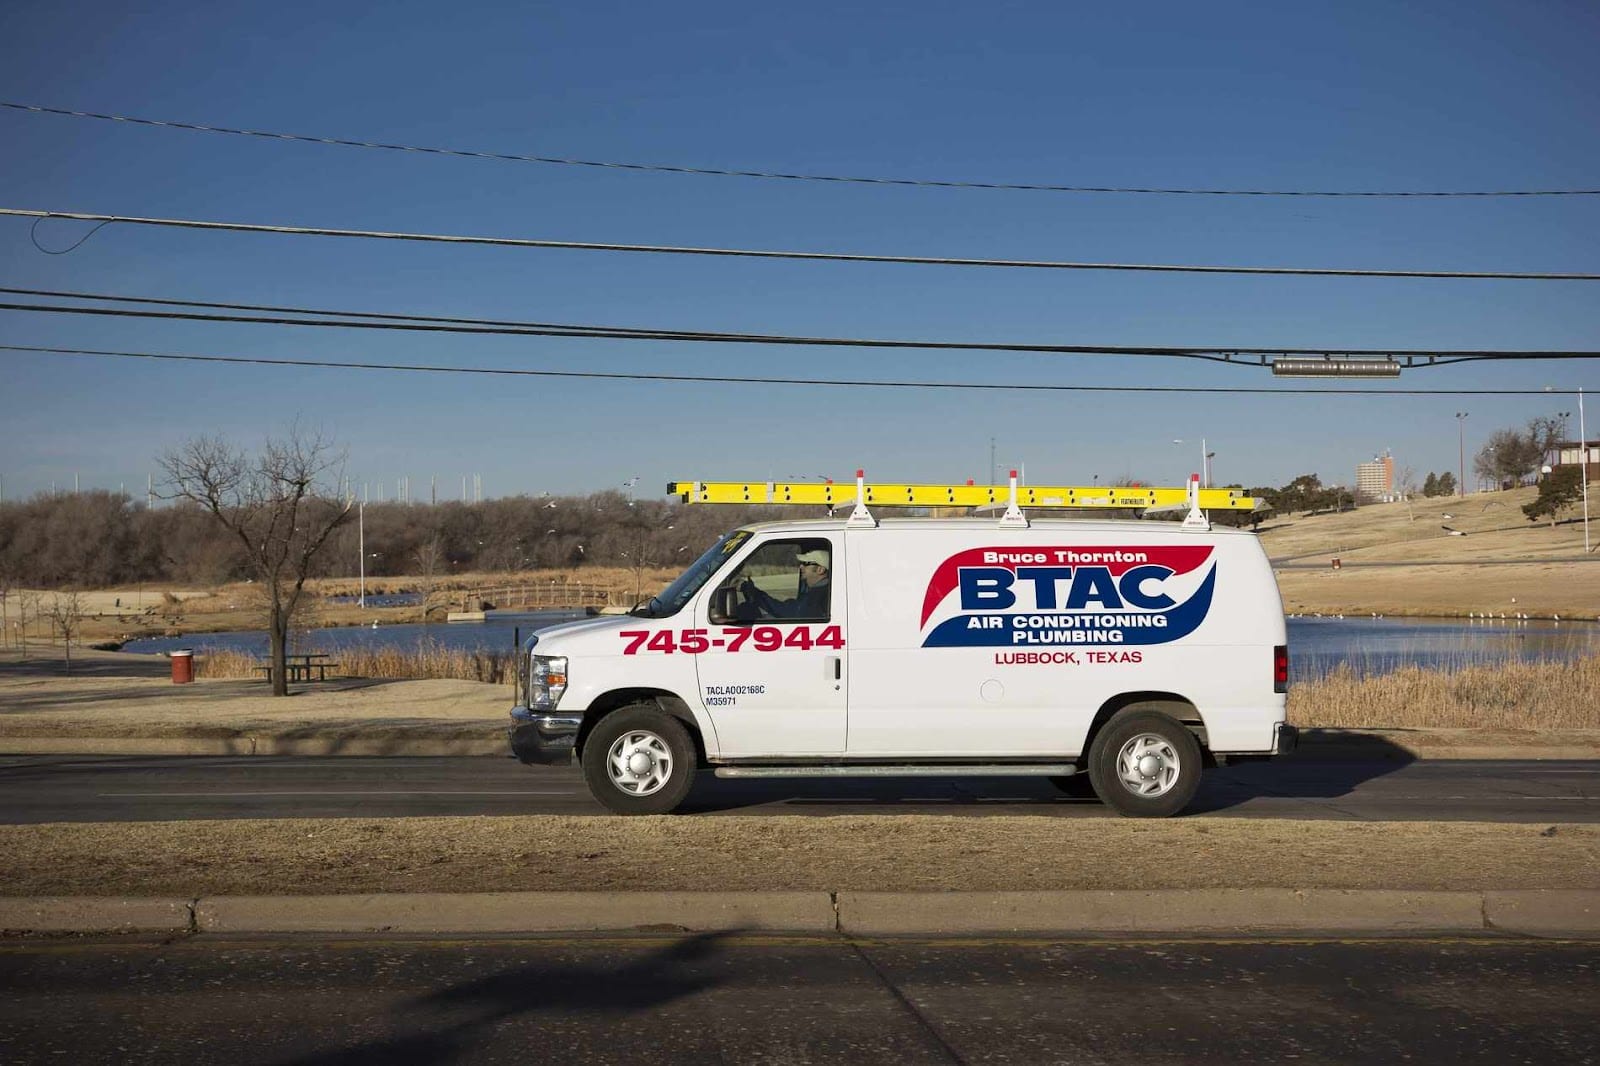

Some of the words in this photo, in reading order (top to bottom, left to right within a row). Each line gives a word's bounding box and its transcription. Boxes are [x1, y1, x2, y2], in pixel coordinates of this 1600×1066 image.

[983, 551, 1047, 564] Bruce
[1054, 551, 1147, 563] Thornton
[958, 565, 1178, 610] BTAC
[967, 615, 1003, 629] AIR
[1012, 614, 1168, 628] CONDITIONING
[619, 626, 846, 656] 745-7944
[1012, 630, 1123, 643] PLUMBING
[995, 651, 1080, 666] LUBBOCK,
[1086, 651, 1142, 663] TEXAS
[706, 697, 736, 706] M35971
